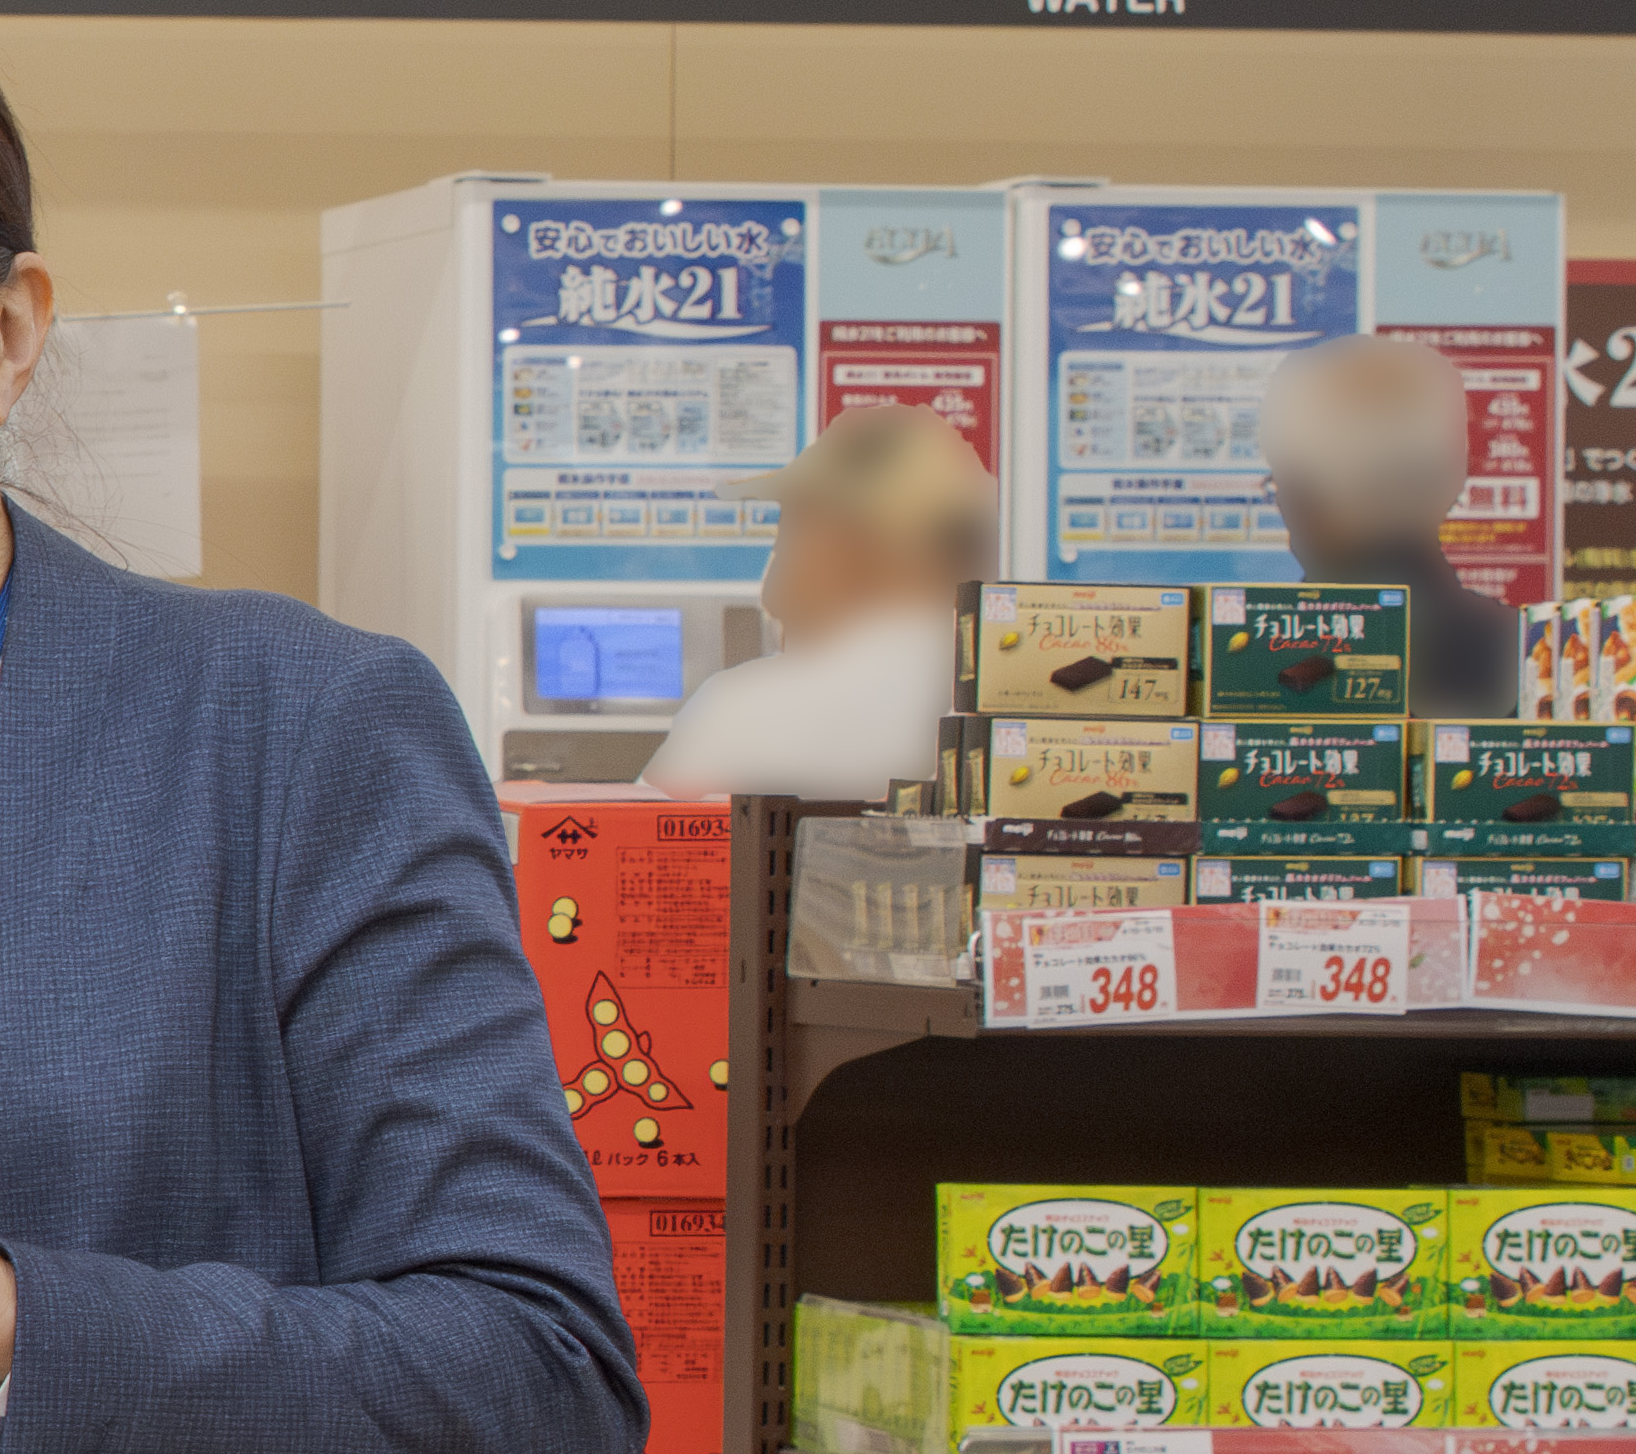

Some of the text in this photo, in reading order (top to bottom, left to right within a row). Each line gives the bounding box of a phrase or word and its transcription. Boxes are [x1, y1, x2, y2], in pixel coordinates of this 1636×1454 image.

[1089, 963, 1159, 1014] 348
[1319, 955, 1391, 1003] 348
[999, 1222, 1156, 1260] たけのこの里
[1245, 1225, 1405, 1263] たけのこの里
